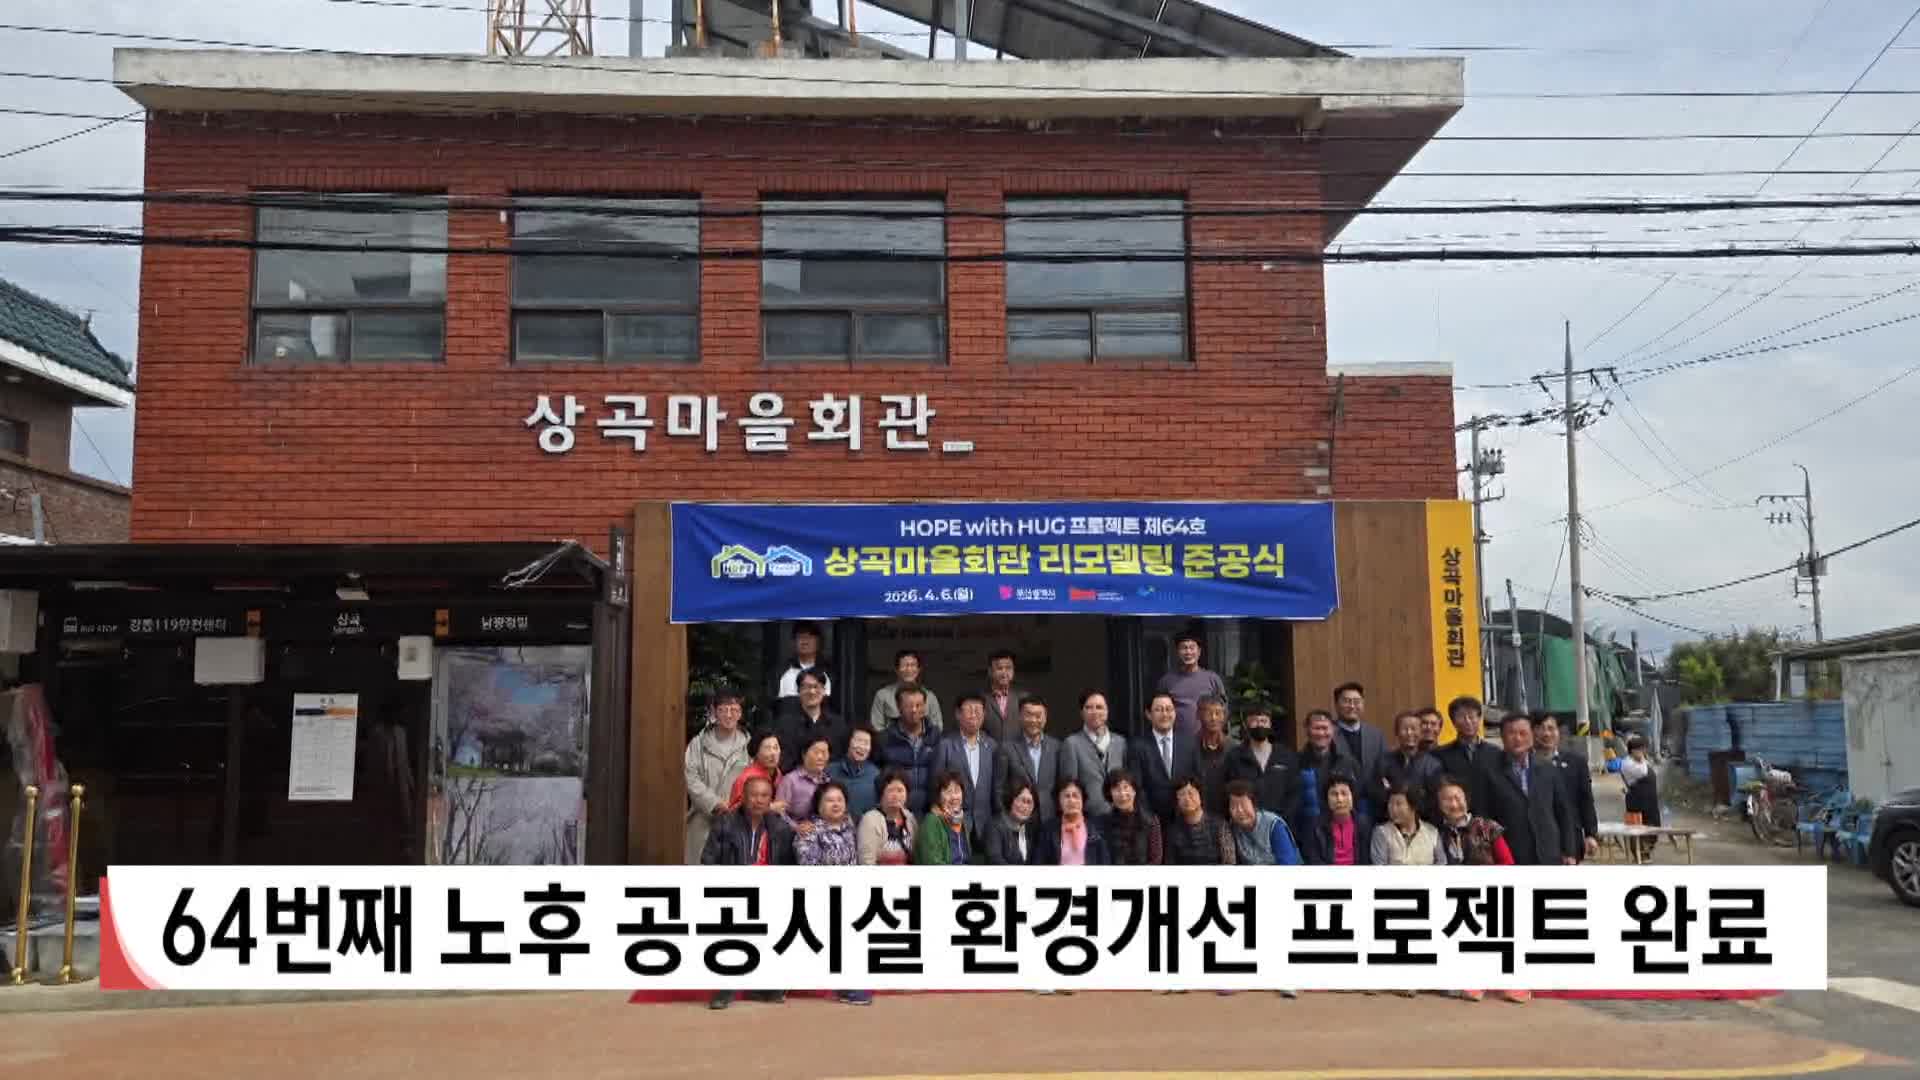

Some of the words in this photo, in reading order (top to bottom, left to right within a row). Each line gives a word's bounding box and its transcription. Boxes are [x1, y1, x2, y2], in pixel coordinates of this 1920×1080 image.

[524, 392, 936, 453] 상곡마을회관
[900, 519, 961, 537] HOPE
[965, 517, 1013, 536] with
[1018, 518, 1065, 536] HUG
[1069, 516, 1140, 535] 프로젝트
[1144, 517, 1207, 536] 제64호
[824, 543, 1031, 577] 상곡마을회관
[1039, 543, 1173, 576] 리모델링
[1182, 543, 1284, 579] 준공식
[1441, 545, 1466, 668] 상곡마을회관
